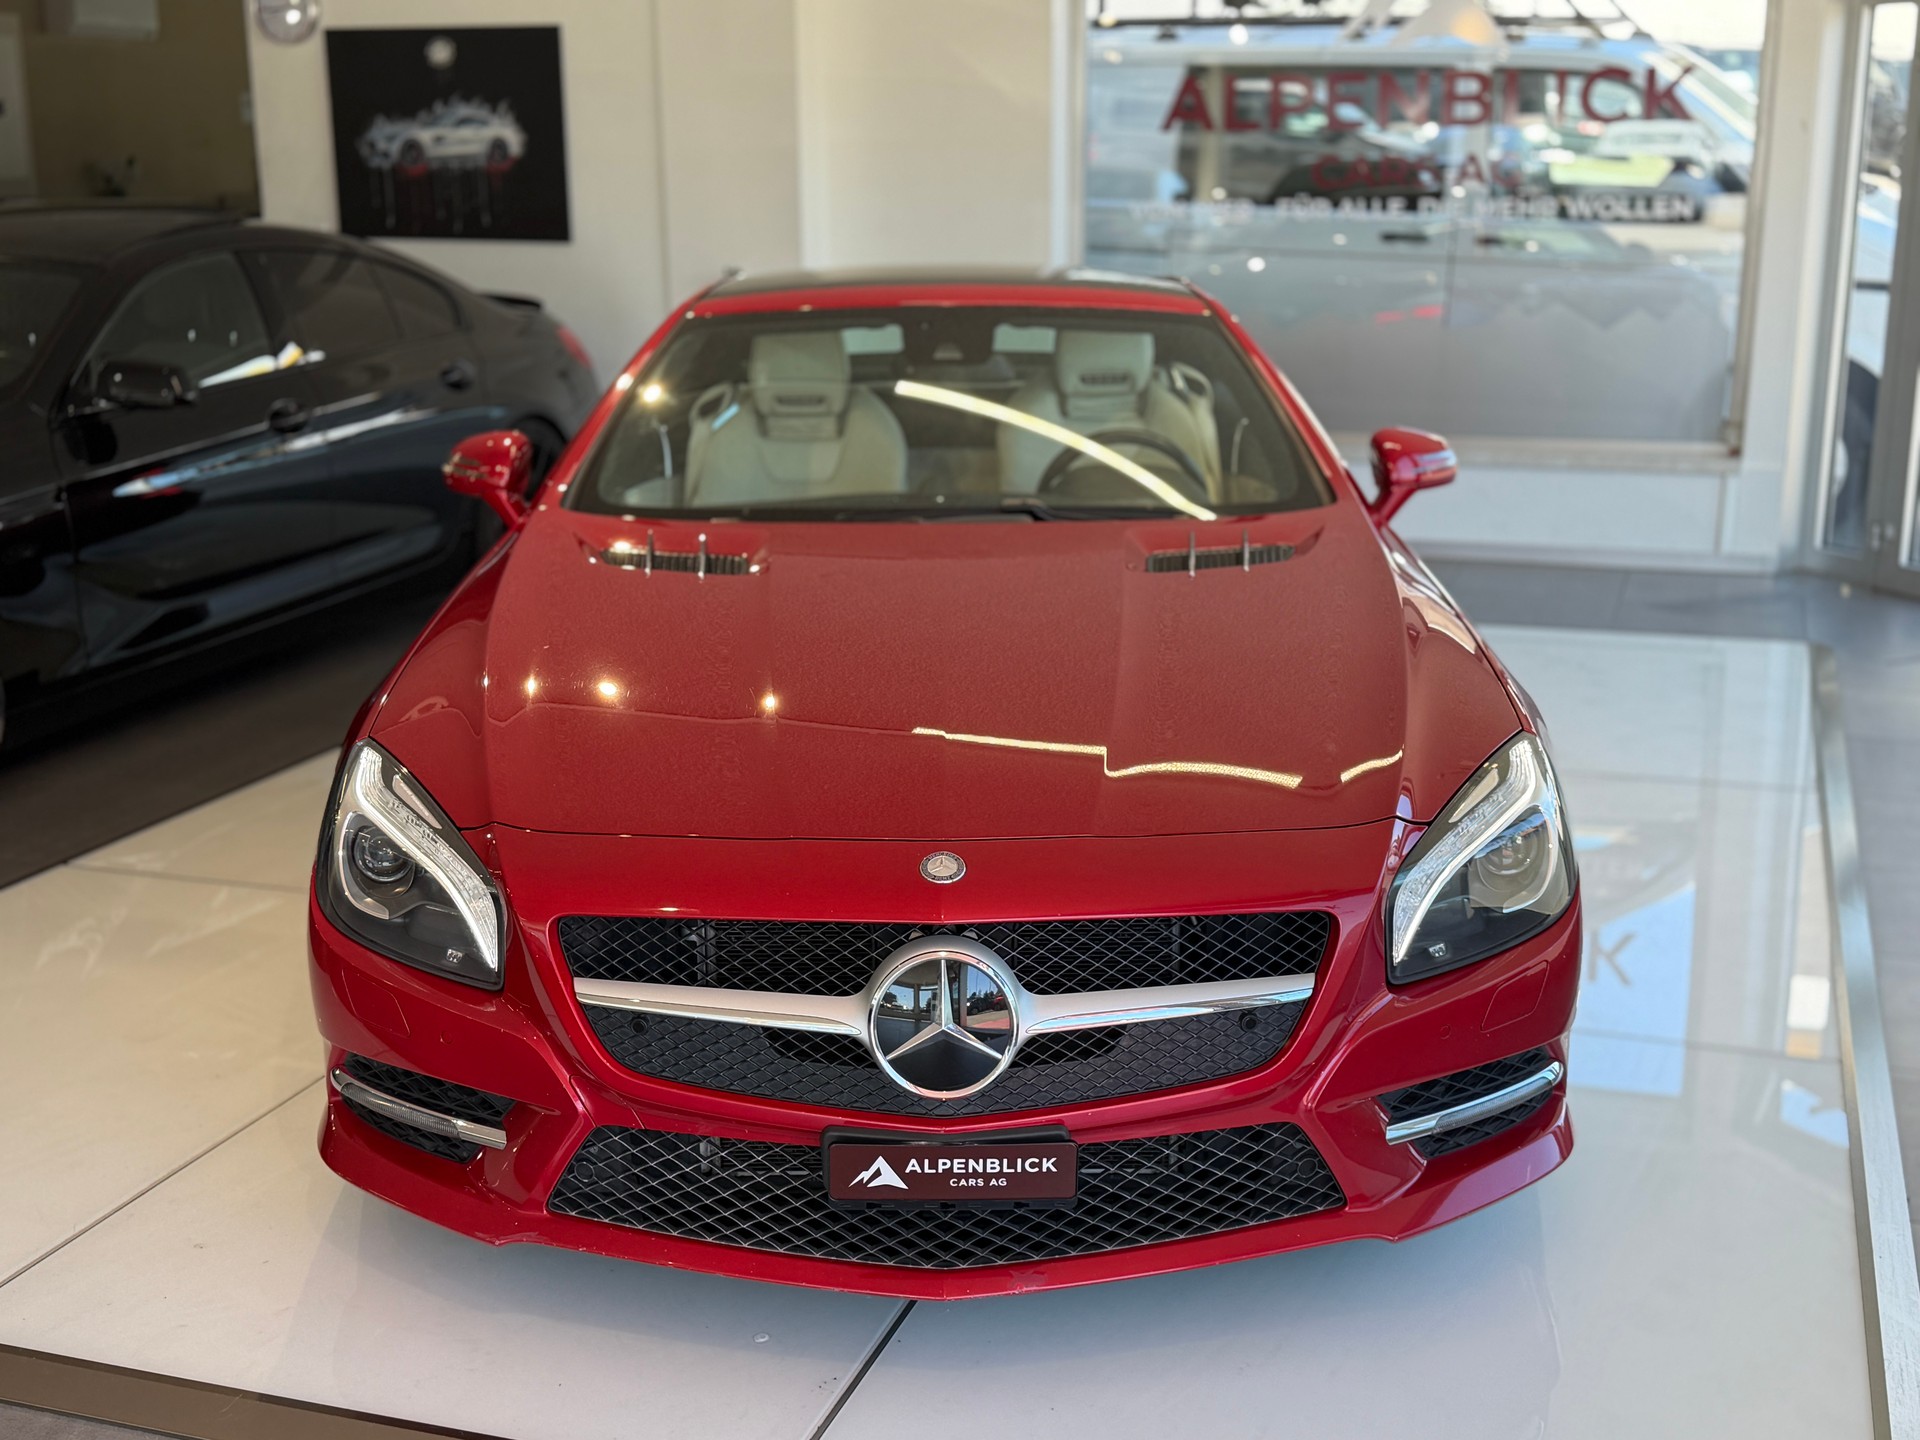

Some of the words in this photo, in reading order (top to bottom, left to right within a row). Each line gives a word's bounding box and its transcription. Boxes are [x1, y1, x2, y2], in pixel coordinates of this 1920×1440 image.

[1162, 66, 1697, 133] ALPENBLICK
[1311, 153, 1440, 190] CARS
[1456, 153, 1520, 188] AG
[1565, 194, 1695, 221] WOLLEN
[905, 1157, 1058, 1174] ALPENBLICK
[950, 1178, 985, 1187] CARS
[989, 1178, 1008, 1187] AG
